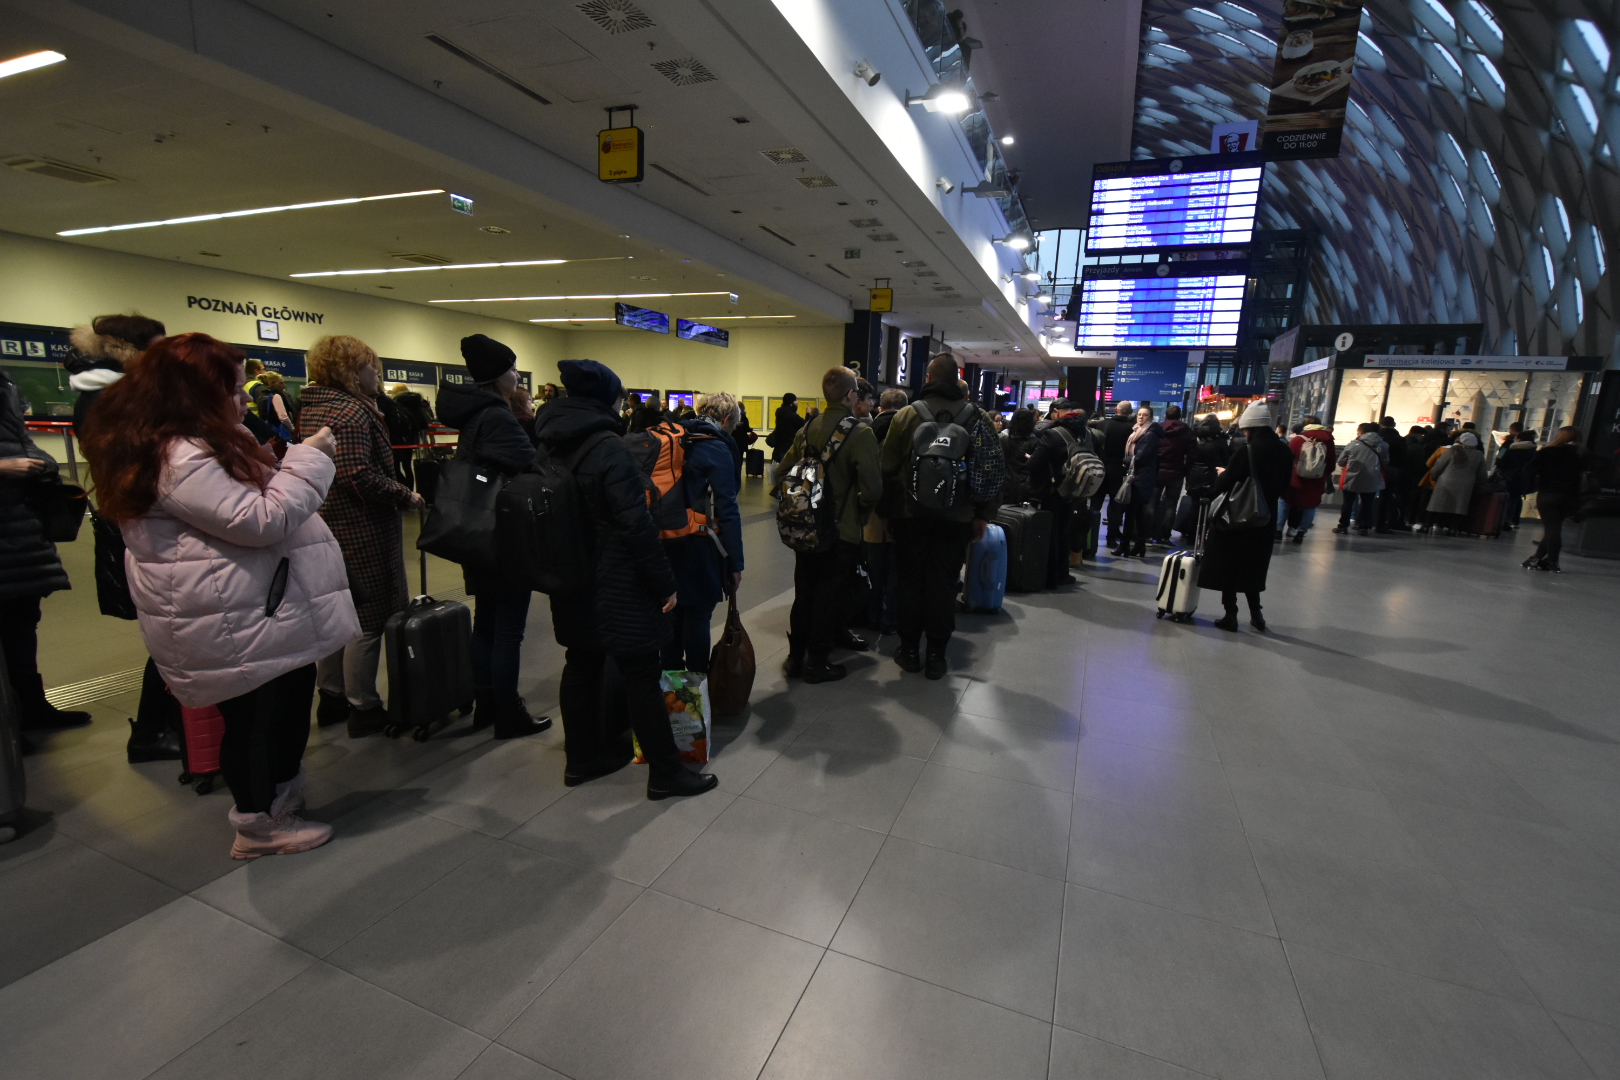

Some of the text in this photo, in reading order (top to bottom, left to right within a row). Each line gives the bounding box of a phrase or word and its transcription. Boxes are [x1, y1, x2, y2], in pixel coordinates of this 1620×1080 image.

[1277, 133, 1327, 142] CODZIENNIE
[1096, 165, 1127, 174] Odjazdy
[1085, 266, 1120, 275] Przyjazdy
[5, 341, 17, 352] R
[1378, 357, 1419, 366] Informacja
[1421, 358, 1456, 366] kolejowa
